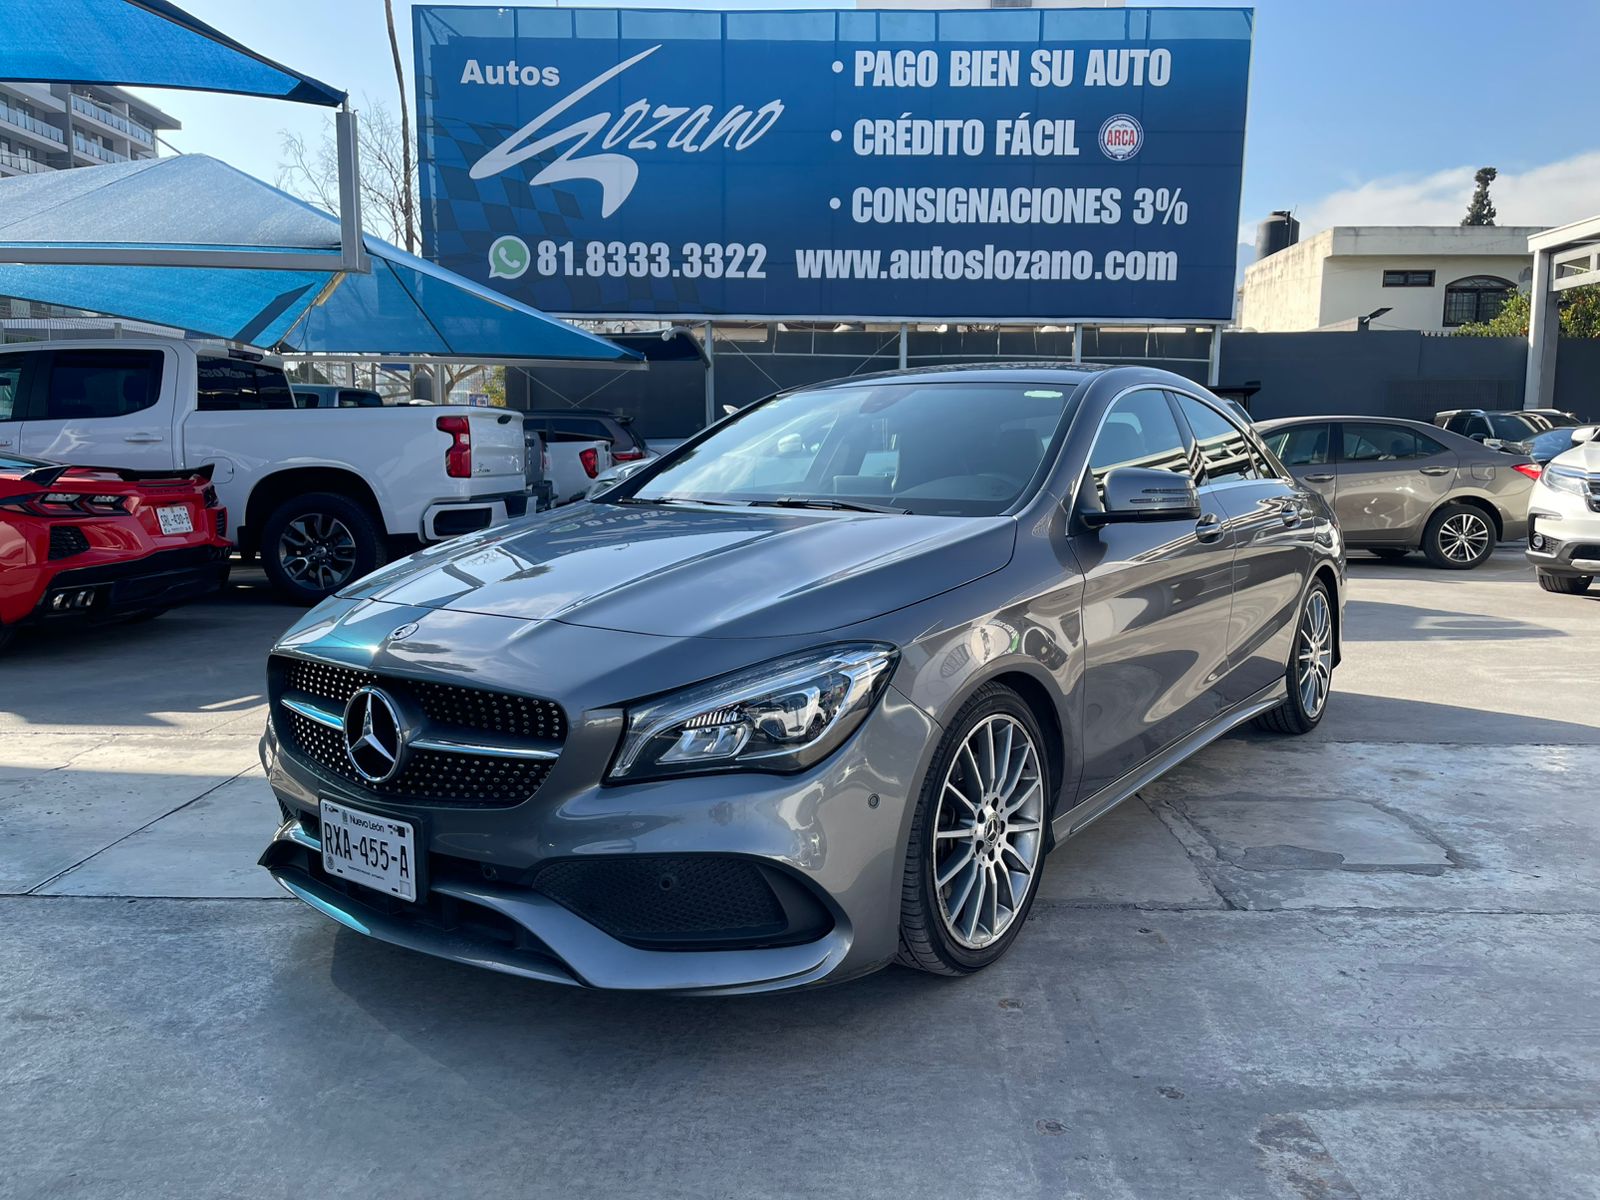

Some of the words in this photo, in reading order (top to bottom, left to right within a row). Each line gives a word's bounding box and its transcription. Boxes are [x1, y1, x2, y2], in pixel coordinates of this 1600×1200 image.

[460, 60, 560, 87] Autos
[854, 50, 938, 87] PAGO
[949, 50, 1019, 87] BIEN
[1030, 49, 1074, 87] SU
[1084, 48, 1172, 87] AUTO
[852, 112, 984, 156] CRÉDITO
[995, 112, 1080, 156] FÁCIL
[1106, 129, 1135, 146] ARCA
[851, 187, 1122, 225] CONSIGNACIONES
[1133, 187, 1189, 225] 3%
[537, 240, 767, 280] 81.8333.3322
[795, 245, 1178, 282] www.autoslozano.com
[324, 821, 409, 879] RXA-455-A
